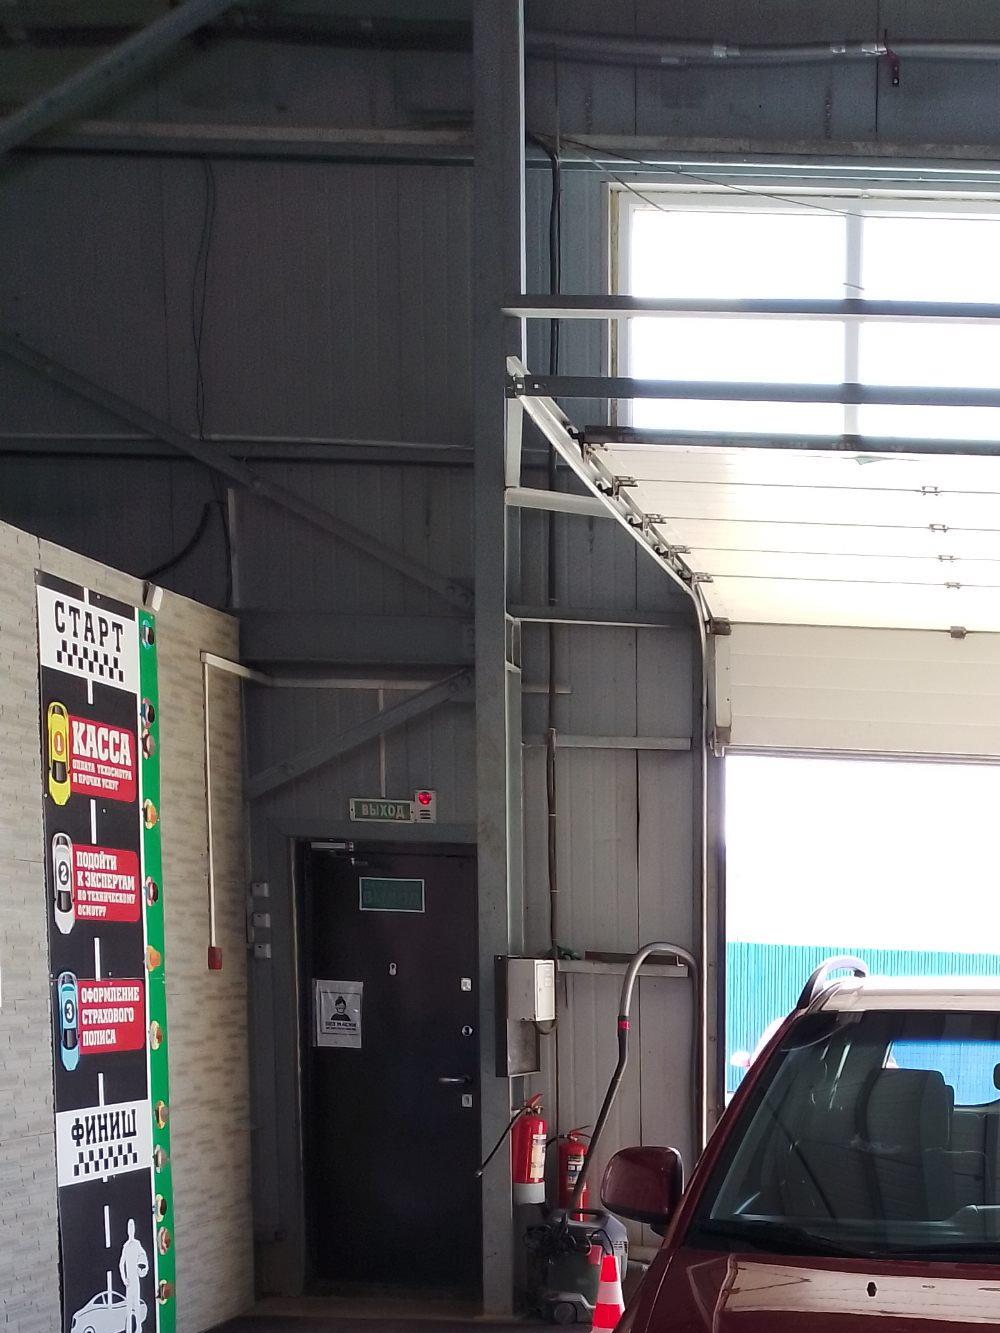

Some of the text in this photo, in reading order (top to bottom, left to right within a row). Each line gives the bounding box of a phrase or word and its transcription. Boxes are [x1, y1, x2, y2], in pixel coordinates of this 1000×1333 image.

[55, 600, 124, 653] СТАРТ
[72, 720, 132, 767] КАССА
[361, 803, 405, 820] ВЫХОД
[76, 850, 117, 870] ПОДОЙТИ
[60, 864, 67, 882] 2
[76, 870, 135, 891] К ЭКСПЕРТАМ
[77, 889, 136, 904] ПО ТЕХНИЧЕСКОМУ
[77, 904, 107, 917] ОСМОТРУ
[81, 986, 140, 1004] ОФОРМЛЕНИЕ
[66, 1003, 73, 1020] 3
[82, 1007, 134, 1025] СТРАХОВОГО
[82, 1029, 117, 1046] ПОЛИСА
[71, 1108, 137, 1147] ФИНИШ
